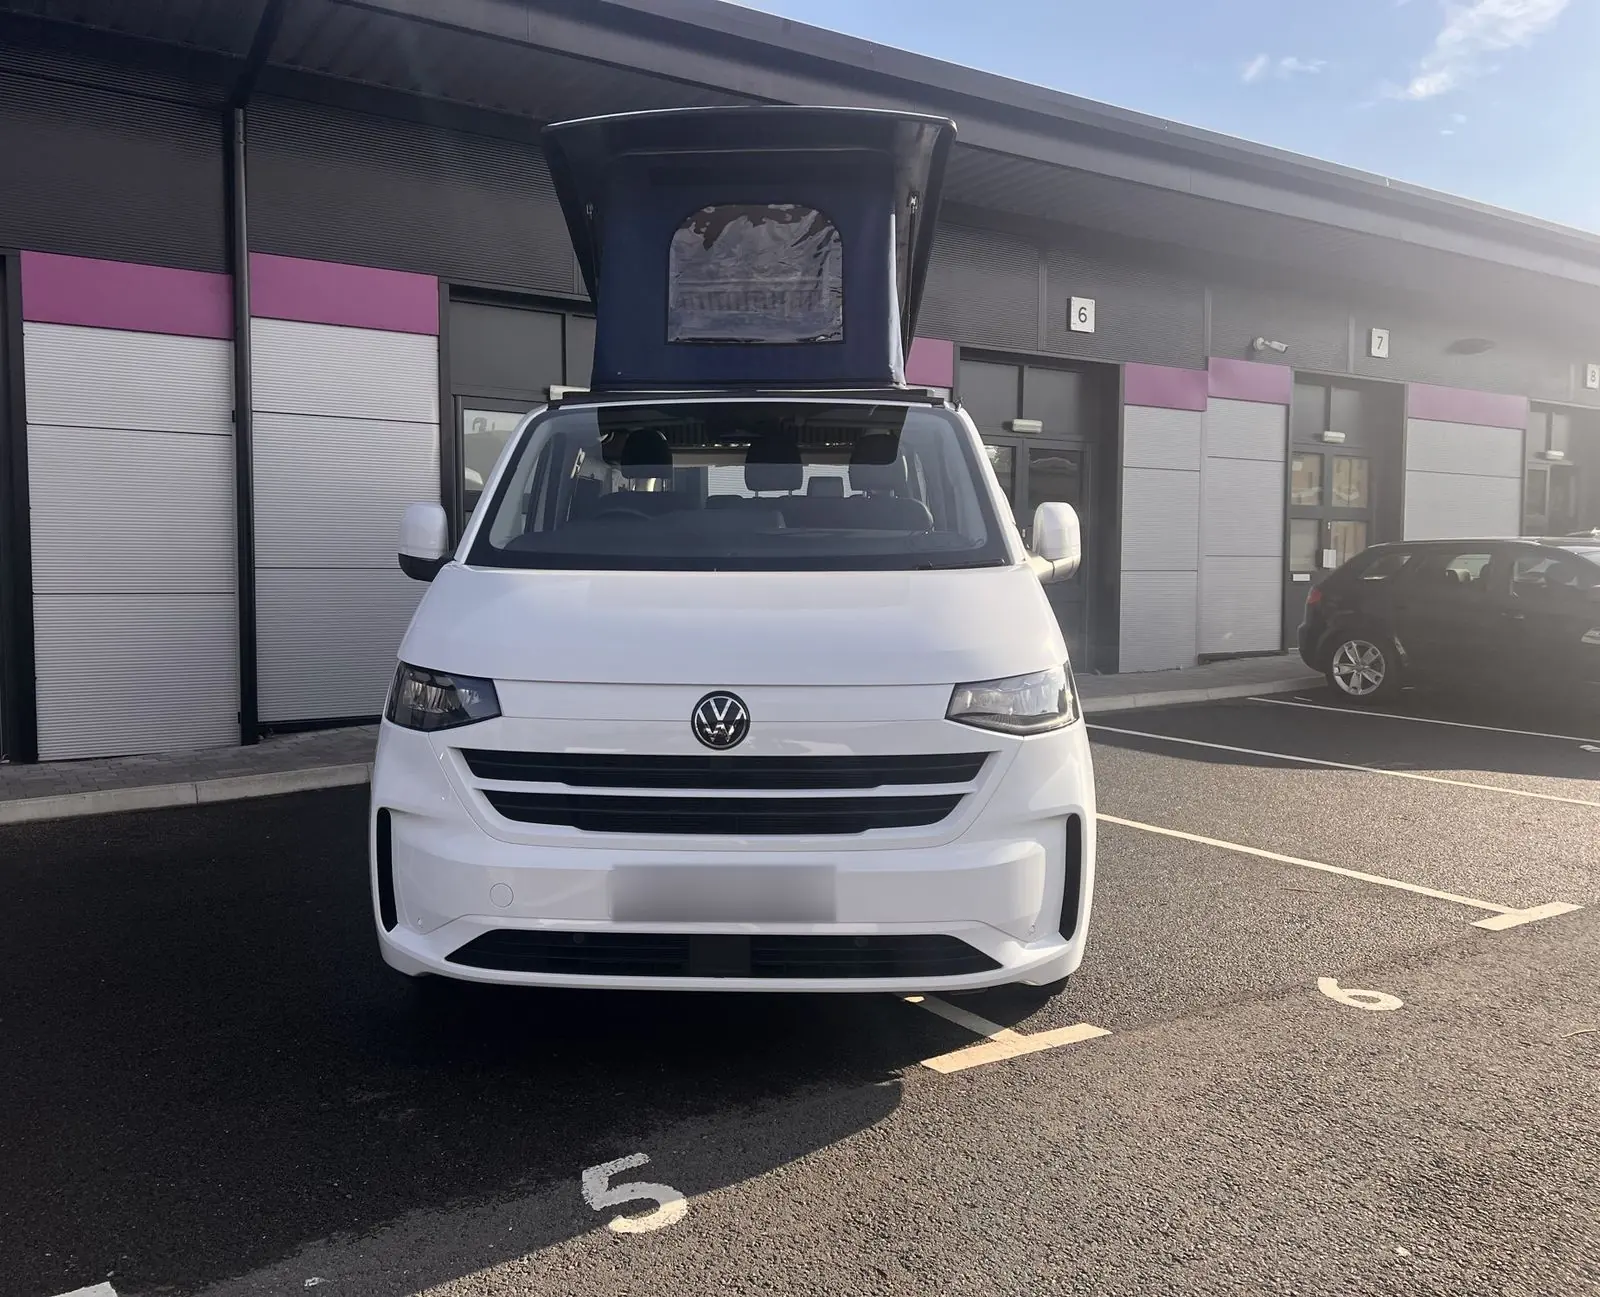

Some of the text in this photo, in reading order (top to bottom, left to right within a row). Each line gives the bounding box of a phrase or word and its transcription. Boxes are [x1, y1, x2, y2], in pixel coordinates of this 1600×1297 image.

[1078, 306, 1088, 323] 6
[1376, 335, 1384, 350] 7
[695, 695, 747, 747] VW
[1317, 976, 1404, 1011] 6
[581, 1152, 689, 1234] 5
